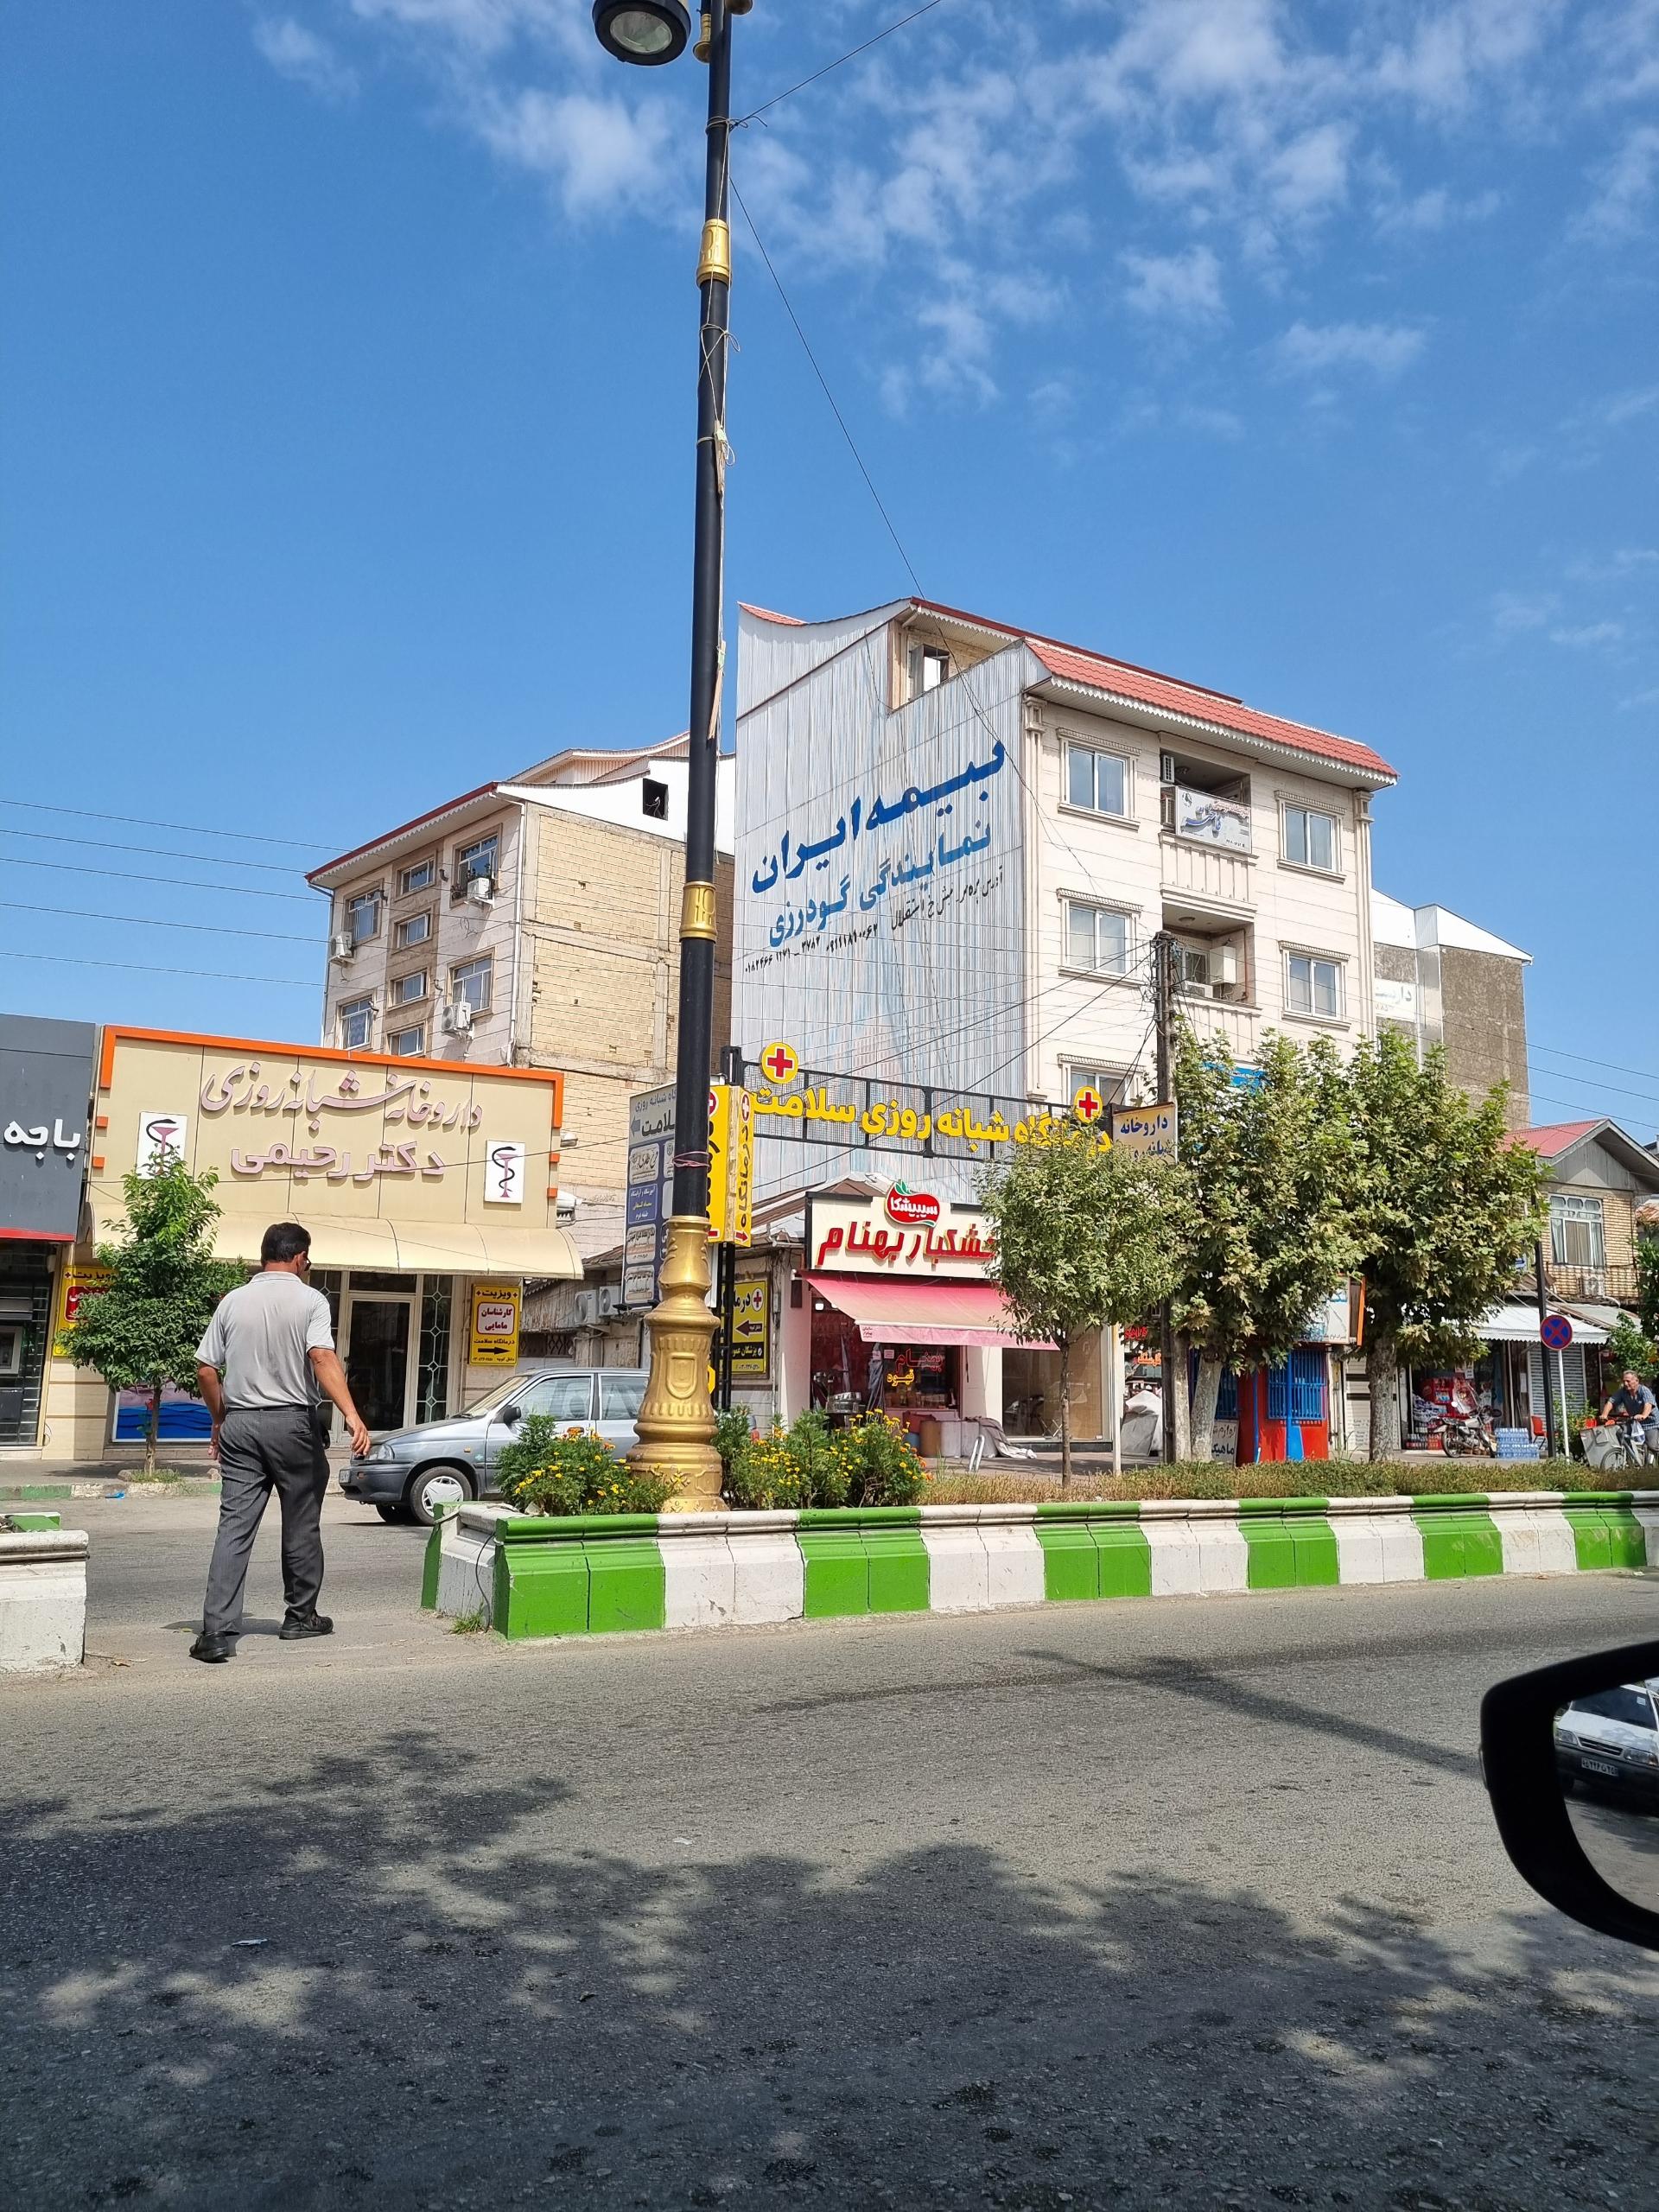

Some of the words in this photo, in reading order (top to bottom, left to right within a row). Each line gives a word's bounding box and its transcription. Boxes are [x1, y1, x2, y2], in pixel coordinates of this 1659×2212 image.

[866, 740, 1005, 831] بیمه
[753, 796, 861, 893] ایران
[860, 820, 991, 912] نمایندگی
[770, 874, 850, 947] گودرزی
[892, 897, 925, 931] استقلال
[752, 1085, 856, 1124] سلامت
[861, 1097, 931, 1141] روزی
[1120, 1114, 1168, 1136] داروخانه
[3, 1118, 81, 1161] باجه
[938, 1105, 1011, 1153] شبانه
[231, 1142, 351, 1179] رحیمی
[354, 1141, 445, 1182] دکتر
[815, 1221, 905, 1268] بهنام
[481, 1290, 512, 1300] ویزیت
[481, 1307, 512, 1318] کارشناسان
[485, 1321, 508, 1331] مامایی
